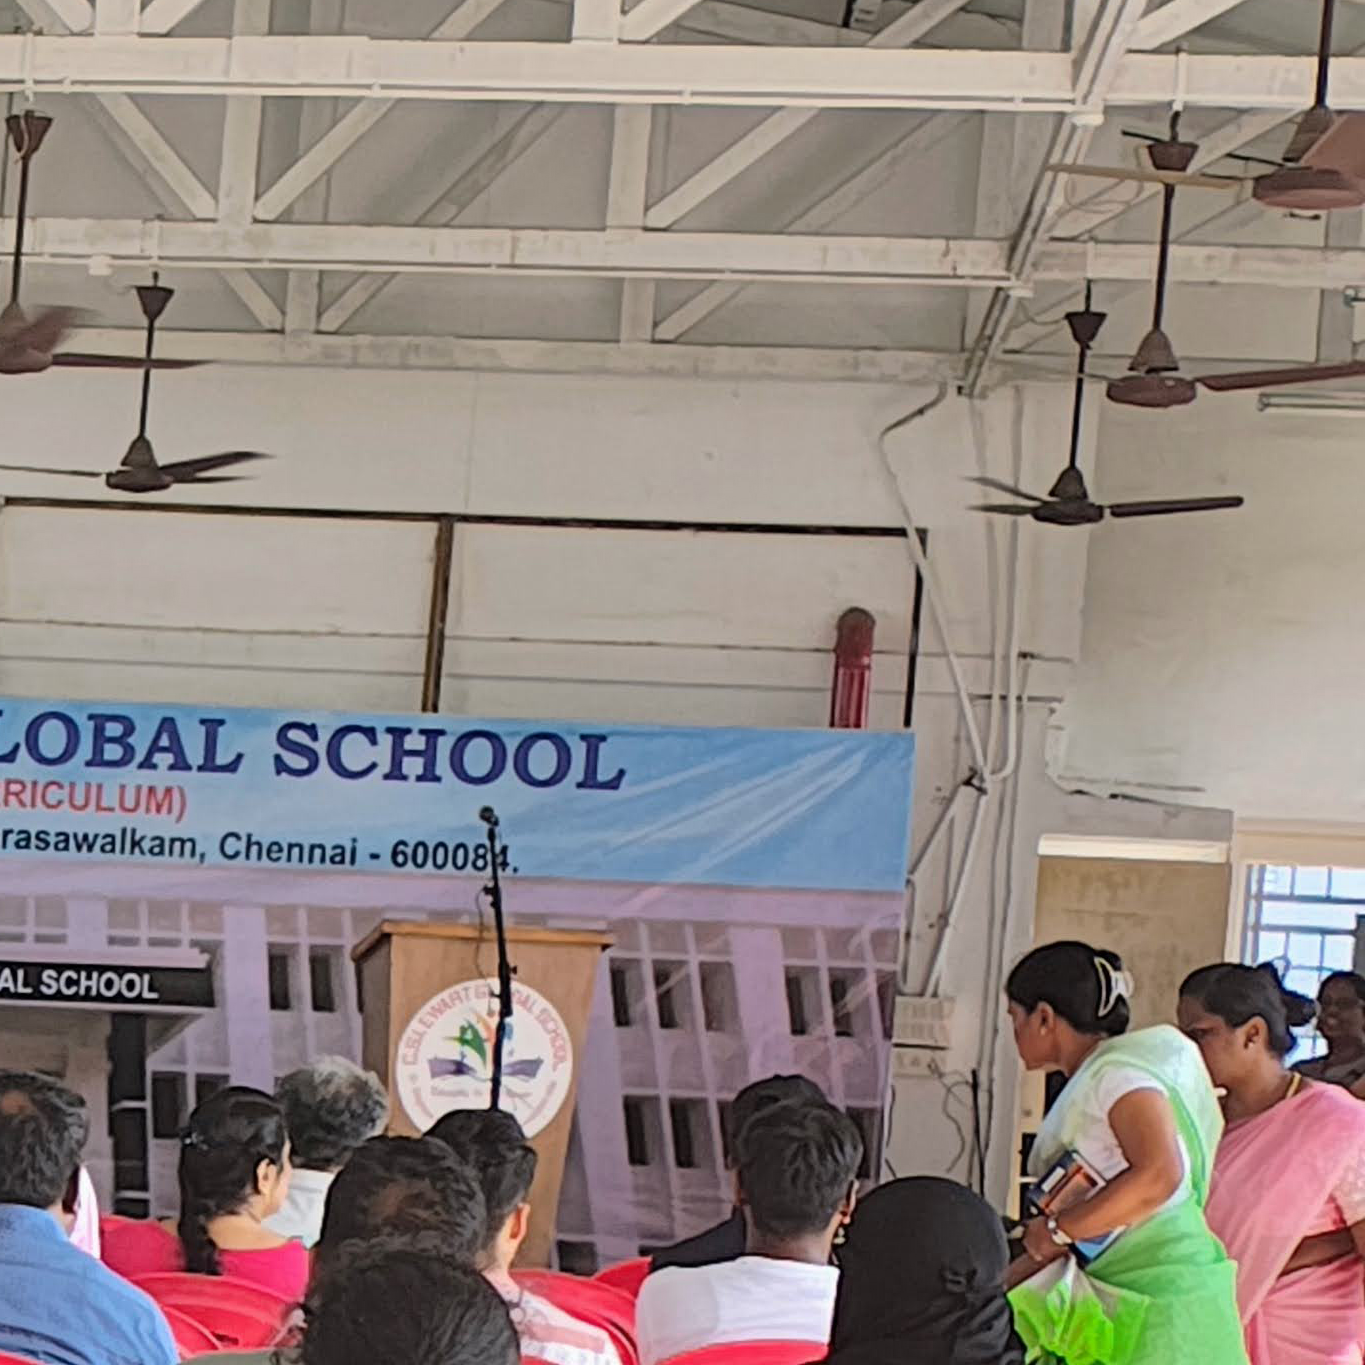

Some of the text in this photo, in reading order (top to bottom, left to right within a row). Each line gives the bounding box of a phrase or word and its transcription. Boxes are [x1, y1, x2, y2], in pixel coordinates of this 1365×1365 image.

[273, 721, 627, 790] SCHOOL
[219, 832, 358, 867] Chennai
[369, 852, 381, 860] -
[390, 839, 519, 874] 600084.
[40, 969, 159, 999] SCHOOL
